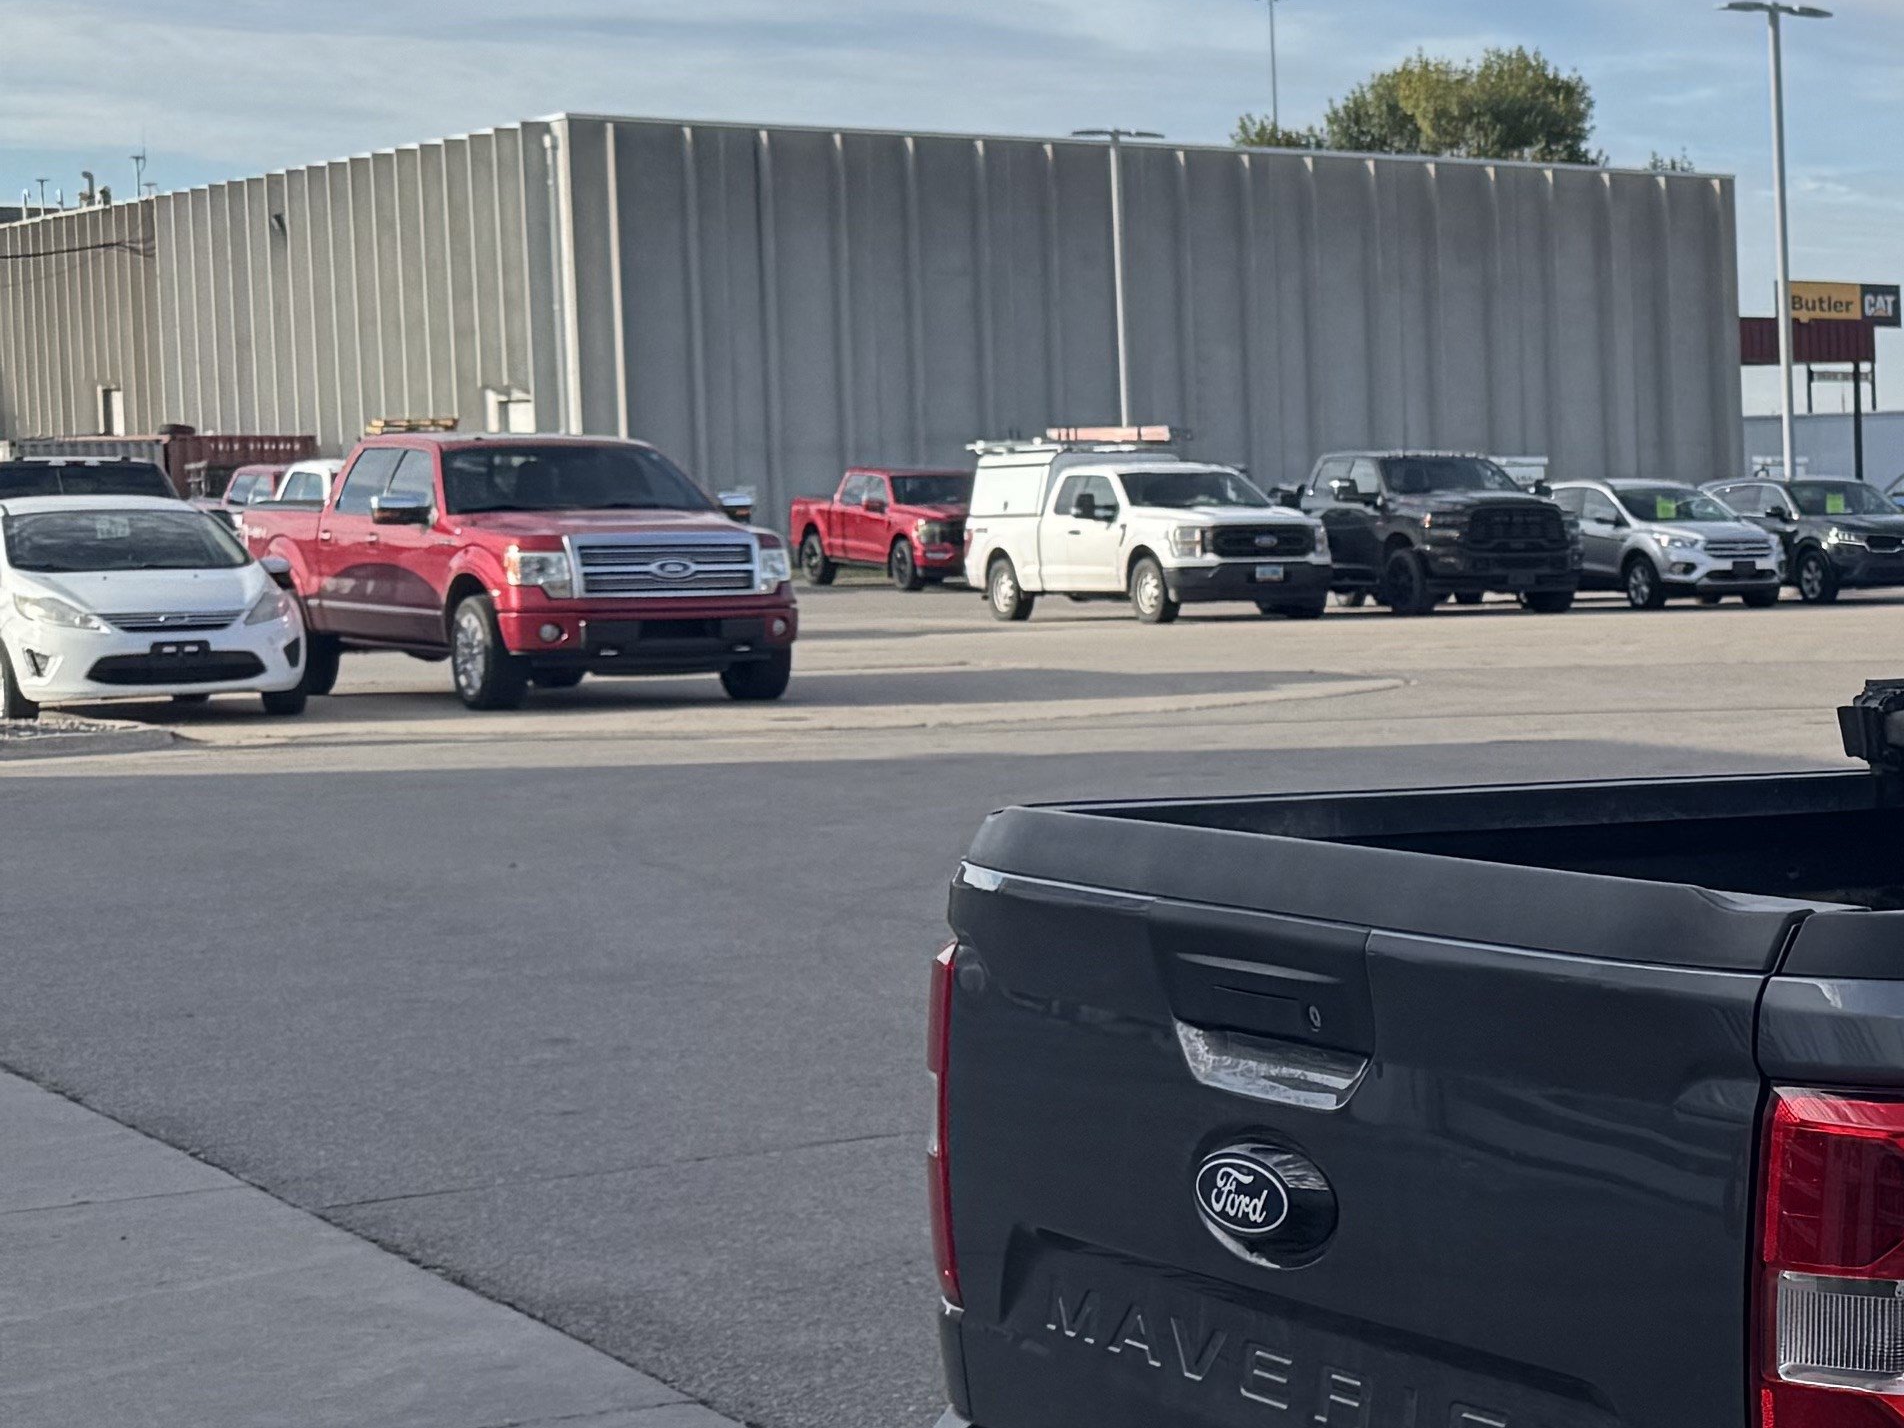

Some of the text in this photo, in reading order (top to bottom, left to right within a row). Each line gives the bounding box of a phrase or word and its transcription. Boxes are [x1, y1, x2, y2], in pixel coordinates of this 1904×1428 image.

[1791, 294, 1895, 317] Butler CAT
[1210, 1166, 1269, 1223] Ford
